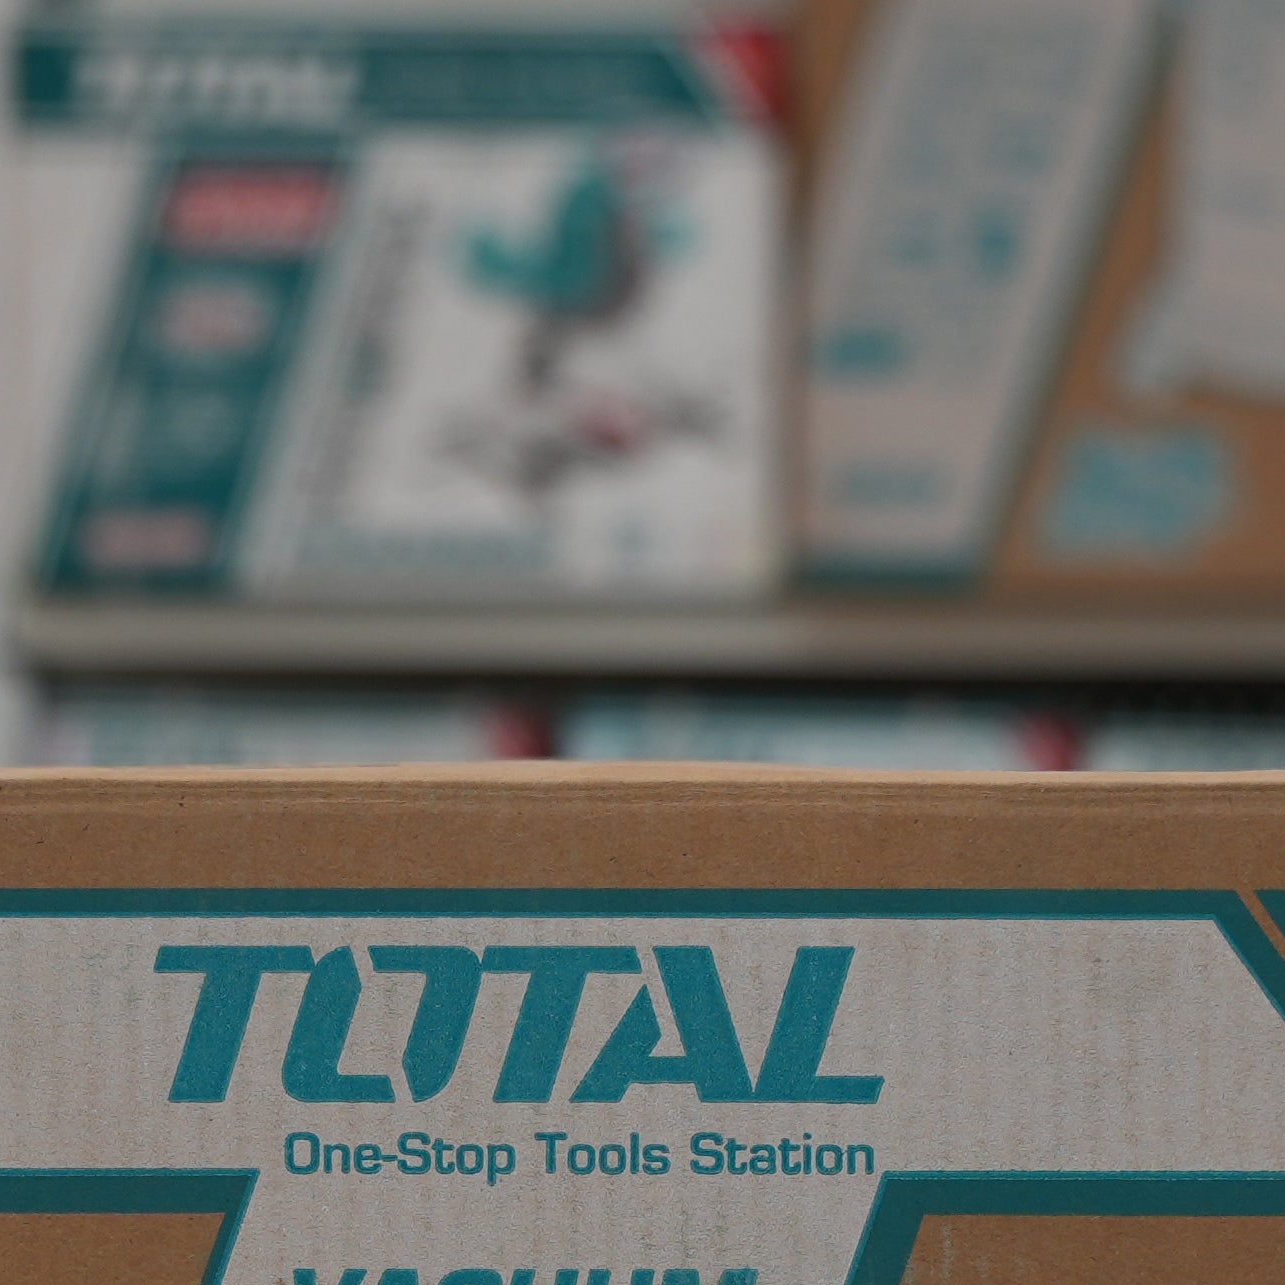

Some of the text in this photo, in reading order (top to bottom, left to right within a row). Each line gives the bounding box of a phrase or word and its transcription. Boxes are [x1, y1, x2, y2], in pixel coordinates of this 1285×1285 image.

[154, 945, 885, 1104] TOTAL
[284, 1131, 876, 1186] One-Stop Tools Station
